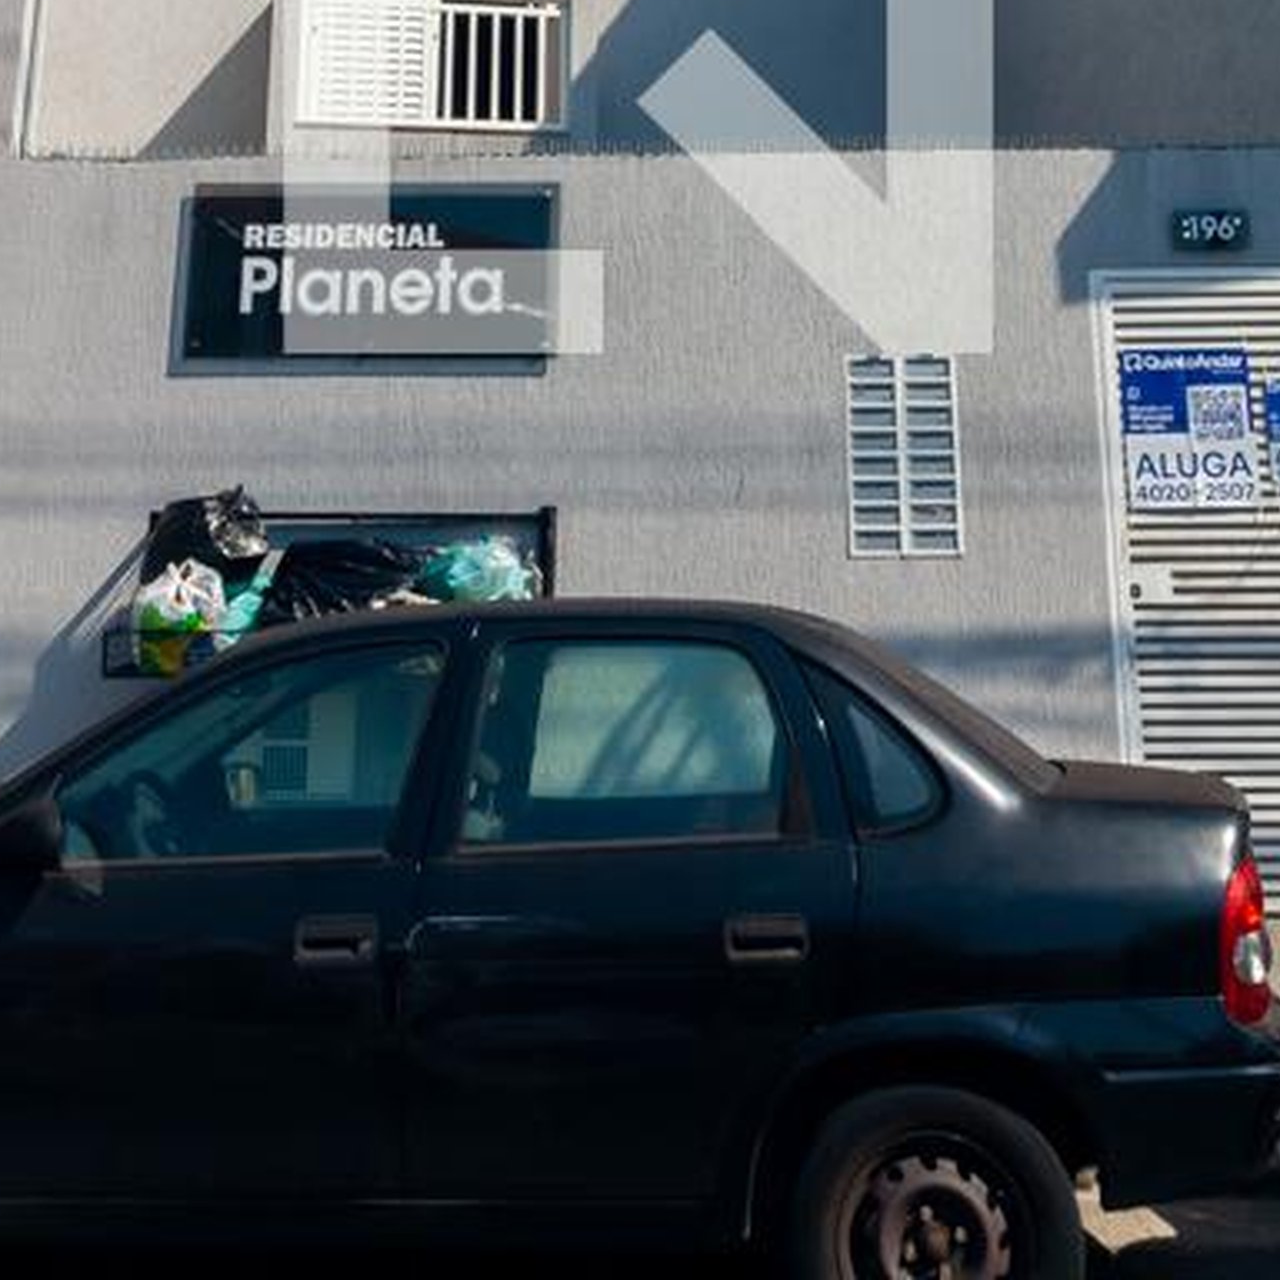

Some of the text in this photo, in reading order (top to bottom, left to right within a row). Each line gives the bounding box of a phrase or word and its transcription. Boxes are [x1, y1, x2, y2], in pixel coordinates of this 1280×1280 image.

[242, 222, 445, 249] RESIDENCIAL
[1189, 215, 1235, 240] 196
[238, 255, 505, 315] Planeta
[1135, 450, 1254, 479] ALUGA
